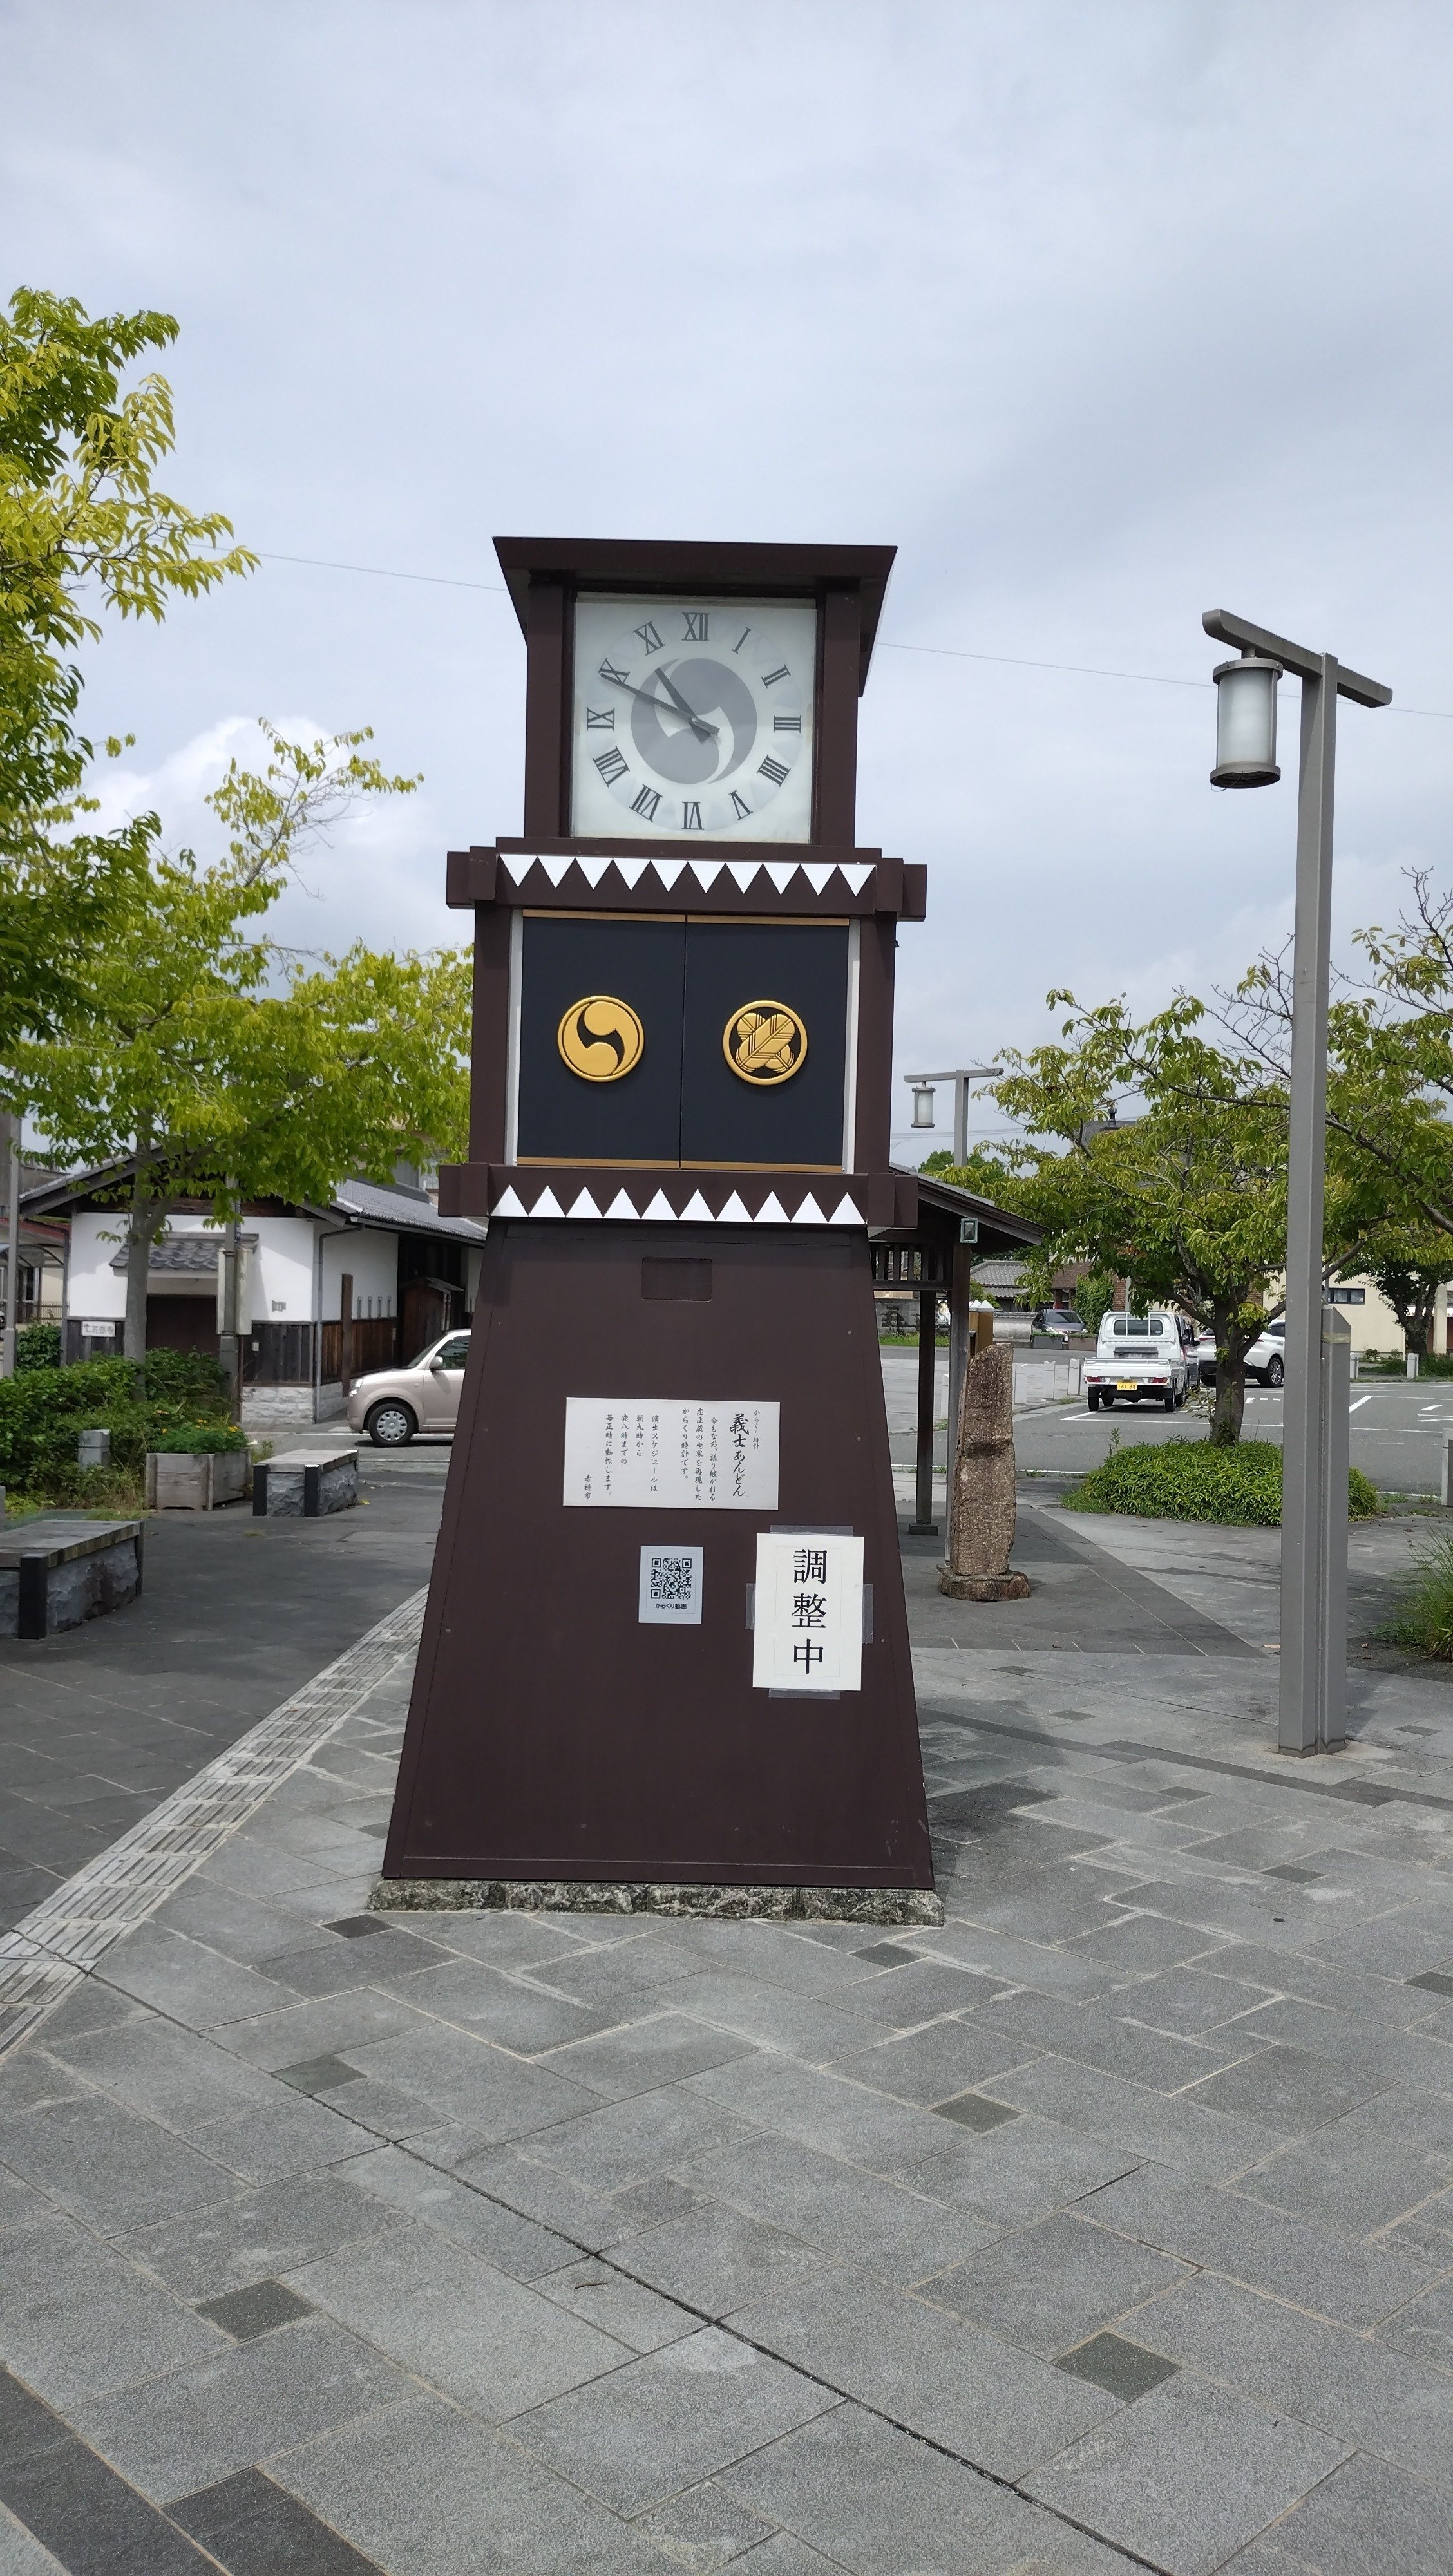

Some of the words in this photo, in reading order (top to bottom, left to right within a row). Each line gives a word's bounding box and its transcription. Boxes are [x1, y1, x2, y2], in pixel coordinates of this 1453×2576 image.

[632, 621, 666, 656] XI
[681, 612, 710, 641] XII
[774, 715, 801, 733] III
[681, 802, 704, 830] VI
[620, 1414, 629, 1464] 夜八時までの
[636, 1414, 645, 1457] 朝九時から
[651, 1414, 660, 1492] 演出スケジュールは
[681, 1408, 690, 1479] からくり時計です。
[694, 1407, 704, 1501] 忠臣蔵の世界を再現した
[730, 1413, 750, 1497] 義士あんどん
[584, 1474, 592, 1500] 赤穂市
[792, 1549, 828, 1674] 調整中
